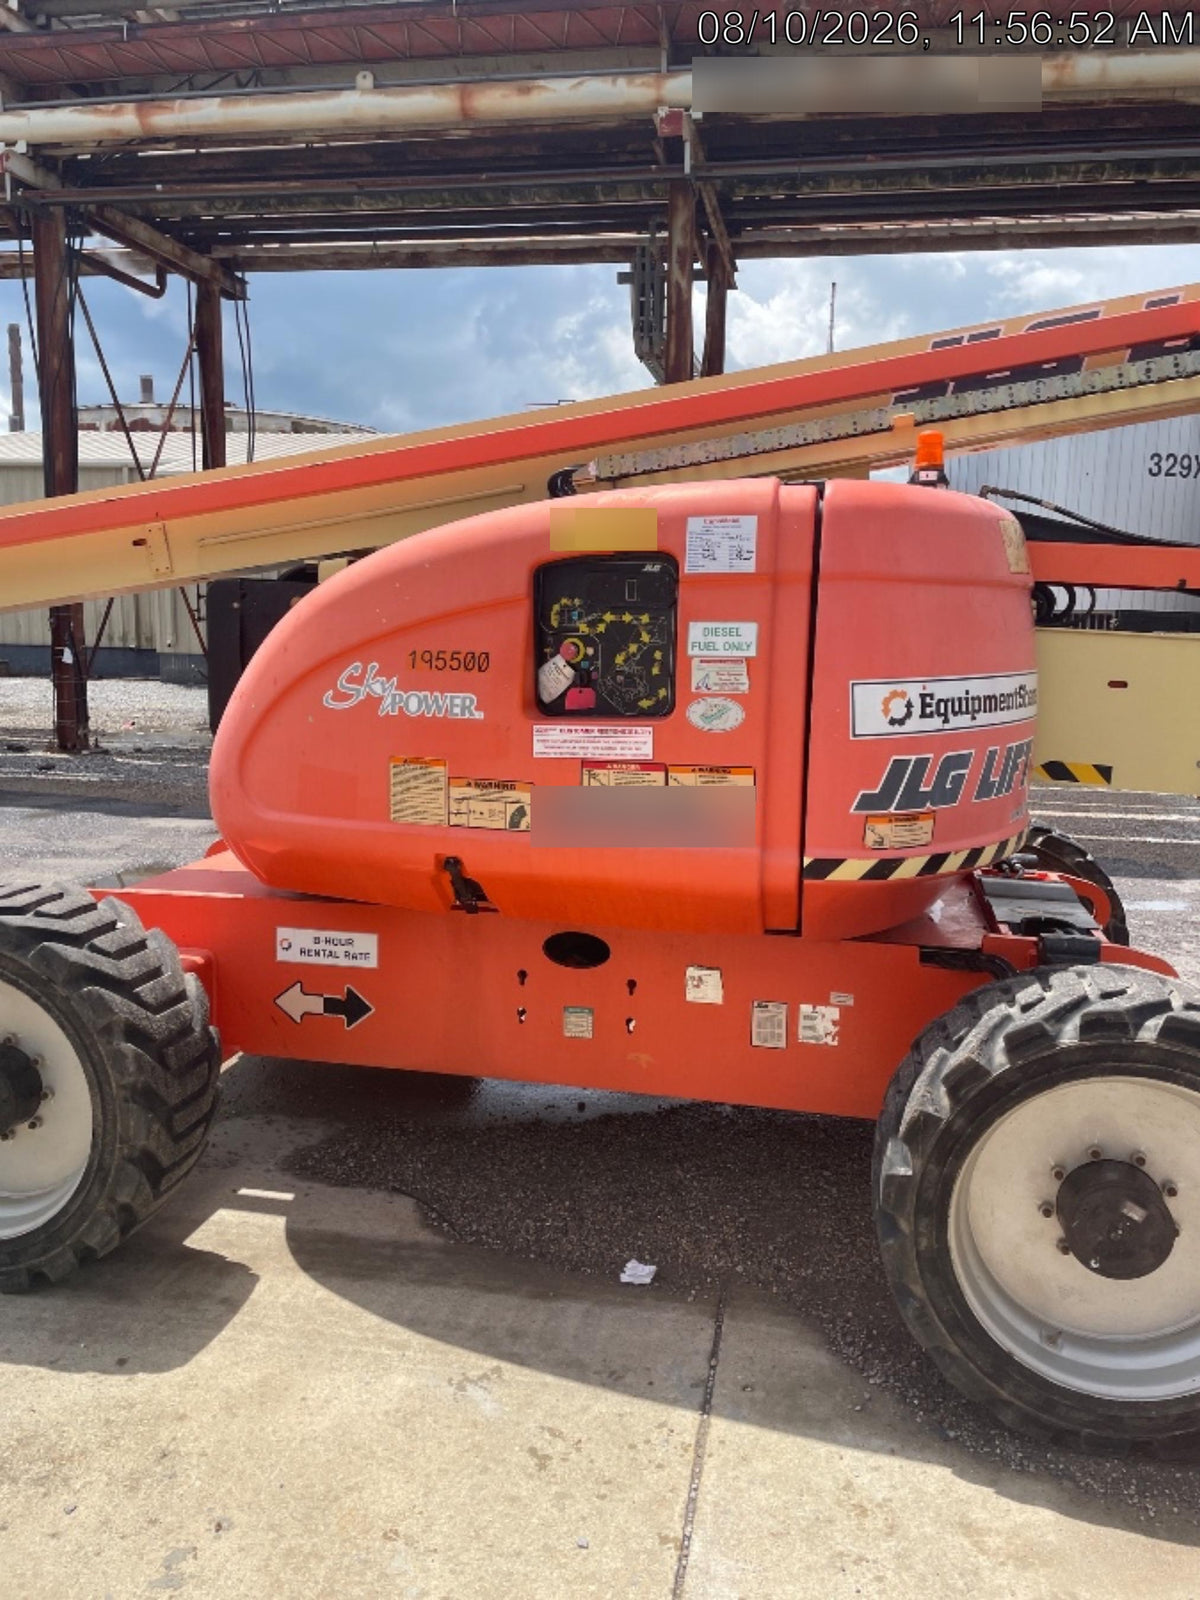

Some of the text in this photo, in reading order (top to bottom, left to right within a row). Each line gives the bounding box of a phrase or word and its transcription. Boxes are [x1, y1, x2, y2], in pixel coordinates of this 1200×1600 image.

[702, 626, 742, 638] DIESEL
[691, 641, 753, 652] FUEL ONLY
[408, 649, 490, 673] 195500
[323, 661, 479, 719] Sky POWER
[851, 749, 975, 813] JLG
[299, 947, 371, 962] RENTAL RATE
